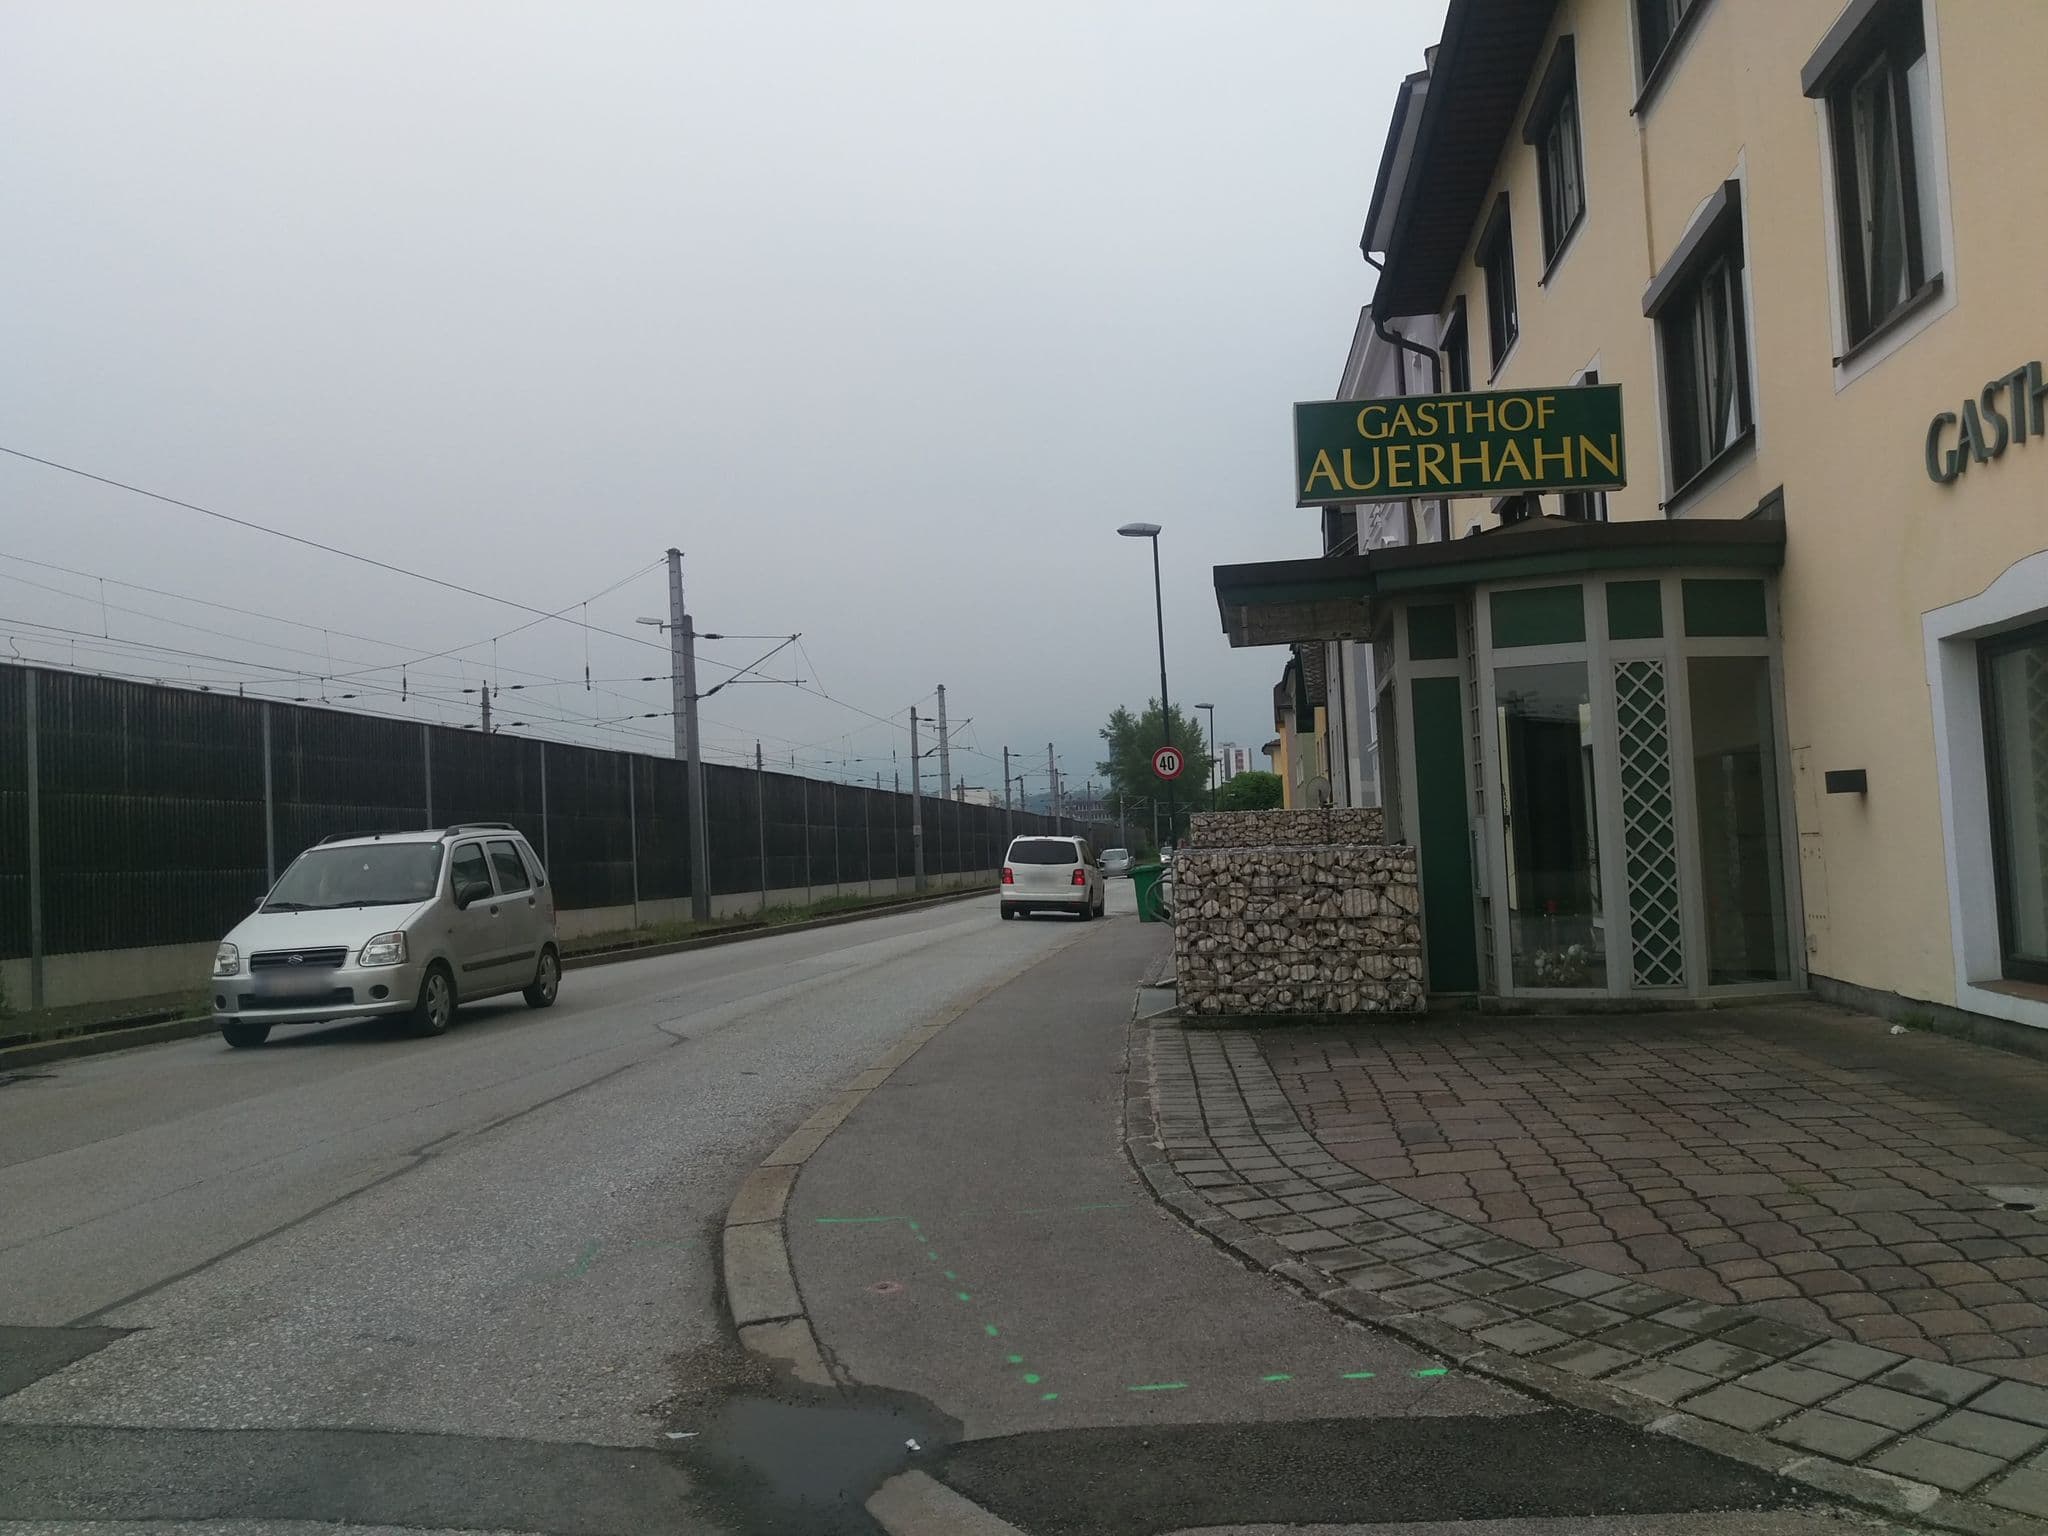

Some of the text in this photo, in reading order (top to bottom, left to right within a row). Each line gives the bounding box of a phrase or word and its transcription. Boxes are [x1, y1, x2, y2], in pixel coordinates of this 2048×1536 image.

[1356, 396, 1555, 439] GASTHOF
[1304, 433, 1620, 492] AUERHAHN
[1159, 755, 1175, 771] 40
